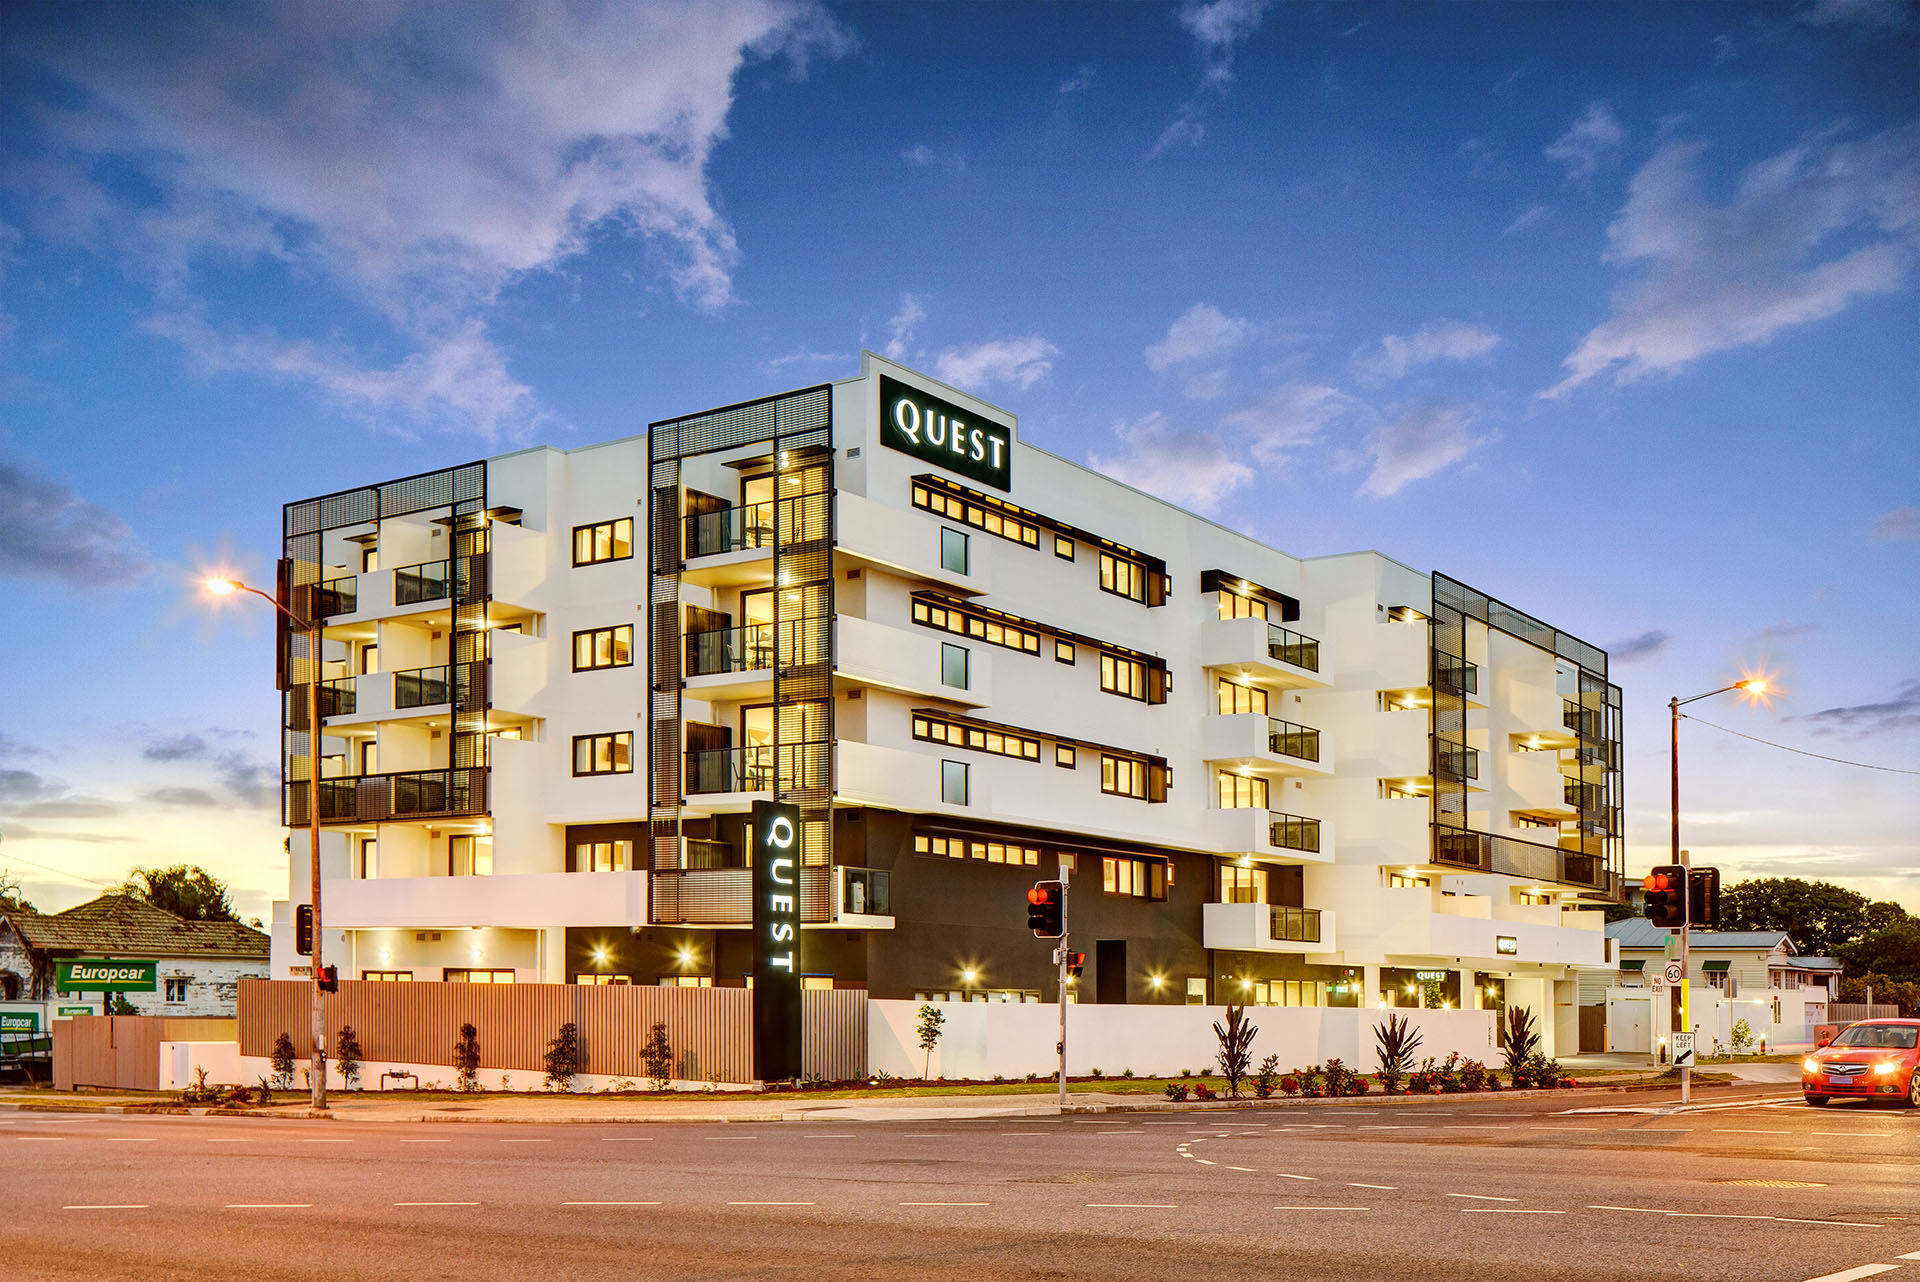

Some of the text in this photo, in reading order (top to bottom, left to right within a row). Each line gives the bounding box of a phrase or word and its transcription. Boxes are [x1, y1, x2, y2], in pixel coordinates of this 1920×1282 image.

[891, 399, 1004, 469] QUEST
[766, 816, 794, 973] QUEST
[70, 965, 146, 984] Europcar
[1416, 971, 1445, 981] QUEST
[1667, 969, 1680, 979] 60
[1652, 985, 1663, 993] EXIT
[1, 1016, 32, 1030] Europcar
